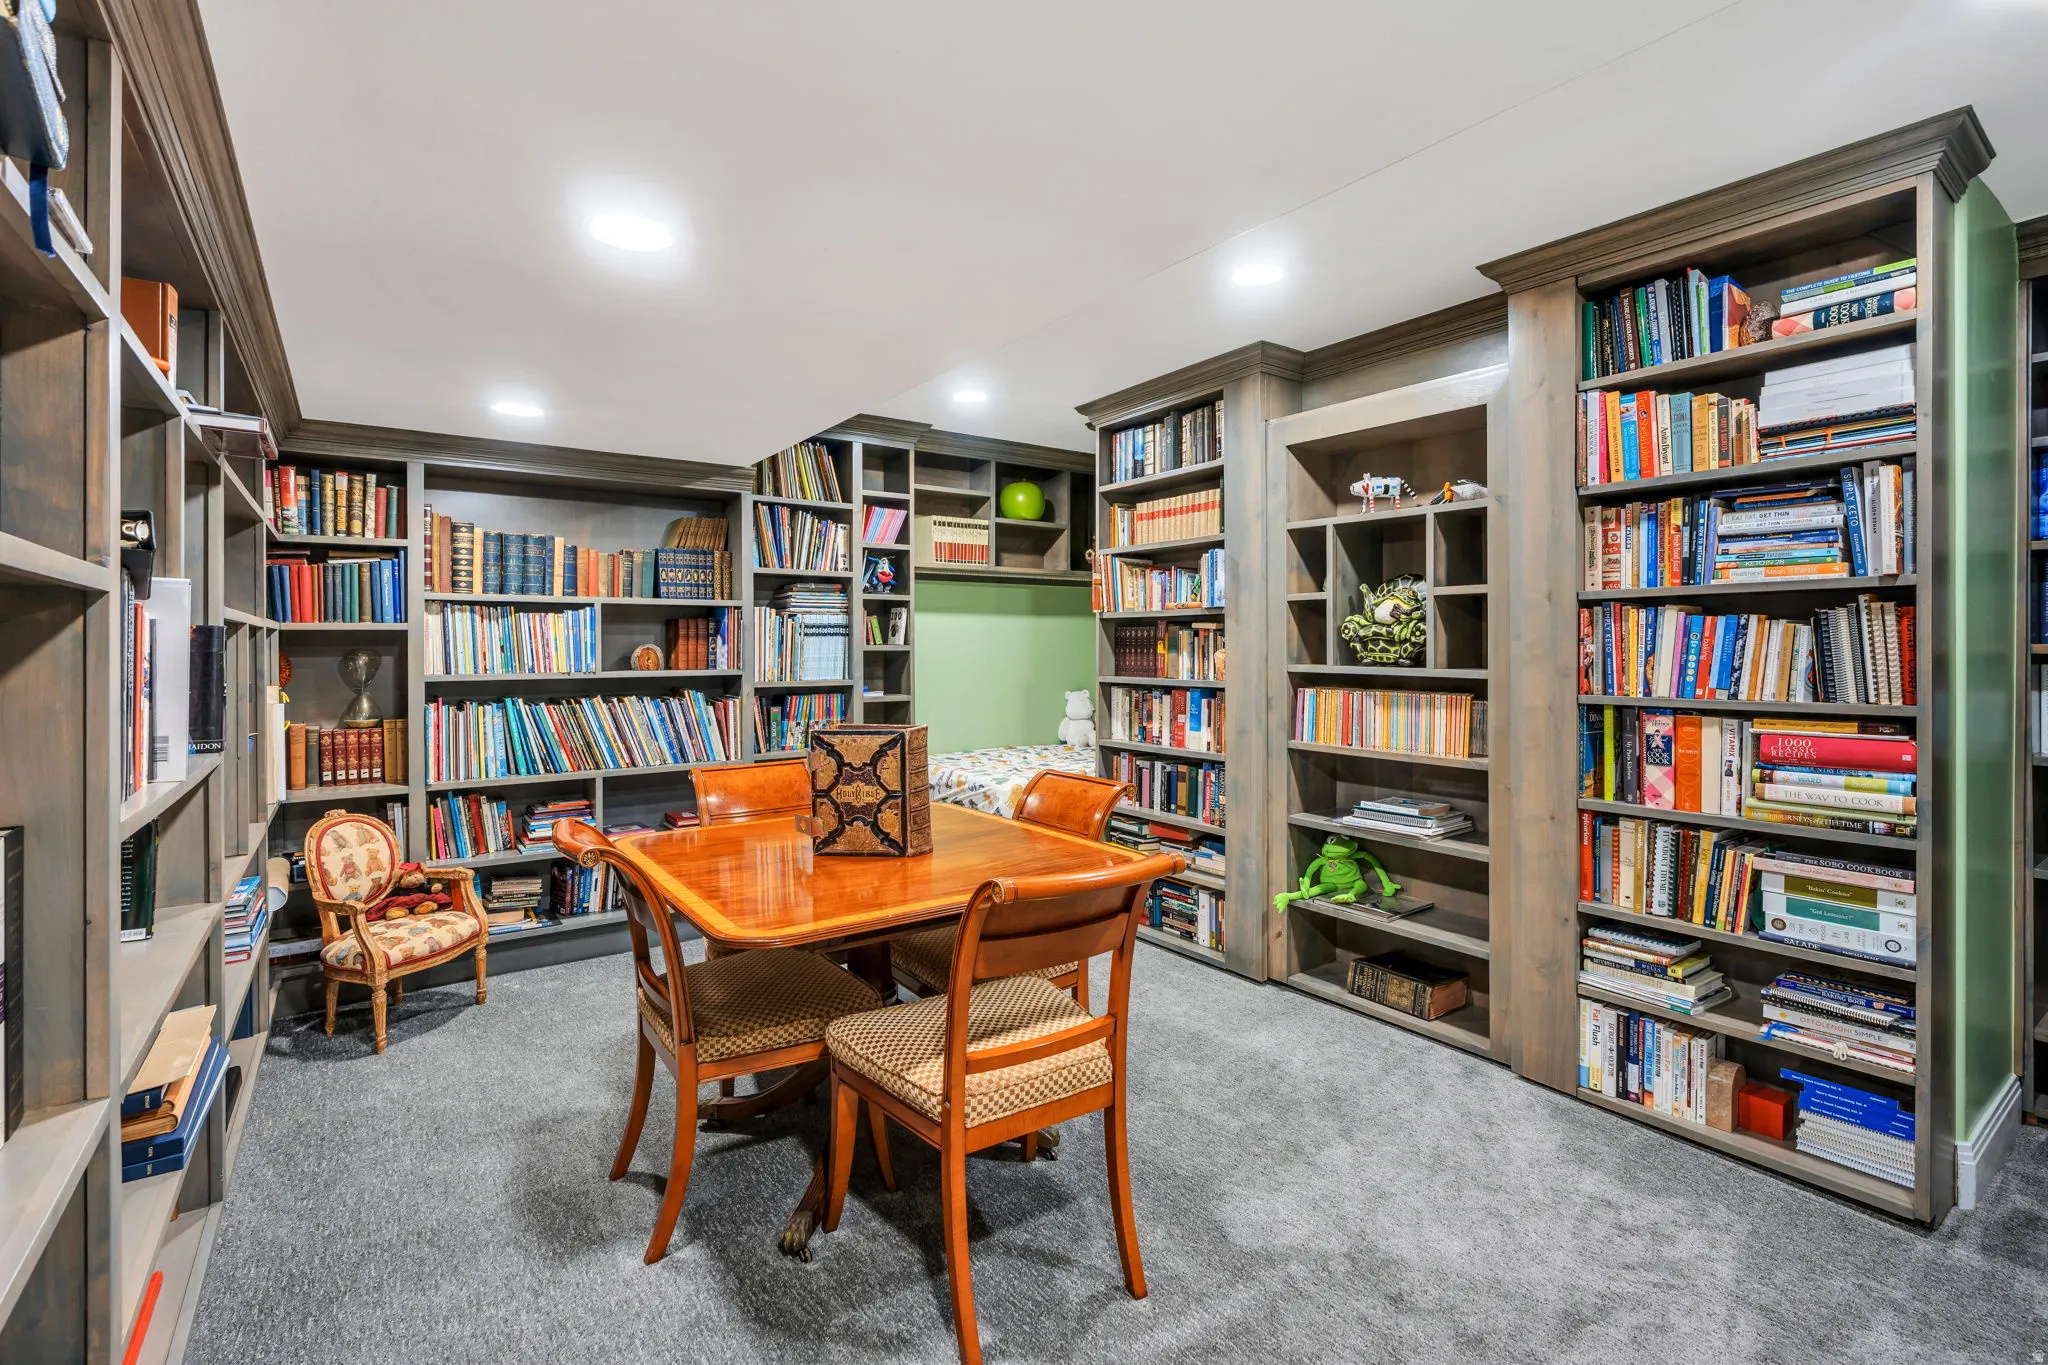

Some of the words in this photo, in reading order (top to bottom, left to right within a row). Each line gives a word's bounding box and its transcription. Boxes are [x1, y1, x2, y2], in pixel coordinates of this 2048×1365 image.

[1796, 282, 1822, 292] COMPLETE
[1823, 278, 1839, 286] GUIDE
[1847, 270, 1871, 280] FASTING
[1661, 427, 1669, 444] Anita
[1661, 444, 1670, 464] Bryant
[1843, 474, 1854, 500] SIMPLY
[1848, 505, 1858, 527] KETO
[1673, 535, 1681, 547] fresh
[1673, 547, 1681, 560] food
[1671, 560, 1680, 572] fast
[1731, 568, 1763, 578] Healthiest
[1700, 638, 1710, 661] baking
[188, 742, 221, 750] AIDON
[1728, 728, 1736, 757] VITAMIX
[1770, 745, 1817, 753] CLASSIC
[1777, 738, 1811, 747] 1000
[1647, 756, 1670, 764] BOOK
[1771, 751, 1817, 759] RECIPES
[1798, 776, 1822, 784] WARD
[836, 787, 856, 799] HOLY
[855, 784, 882, 804] BIBLE
[1784, 790, 1801, 798] THE
[1804, 792, 1829, 802] WAY
[1833, 795, 1847, 804] TO
[1851, 796, 1885, 807] COOK
[1825, 819, 1863, 829] LIFETIME
[1700, 848, 1711, 865] kind
[1819, 859, 1844, 869] SOBO
[1846, 864, 1903, 878] COOKBOOK
[1784, 938, 1821, 950] SALADE
[1361, 967, 1369, 997] STANDARD
[1365, 968, 1373, 998] DICTIONARY
[1821, 991, 1847, 1001] BAKING
[1848, 997, 1866, 1006] BOOK
[1593, 1008, 1601, 1021] Fat
[1592, 1024, 1601, 1046] Flush
[1799, 1017, 1853, 1034] OTTOLENGHI
[1854, 1030, 1882, 1041] SIMPLE
